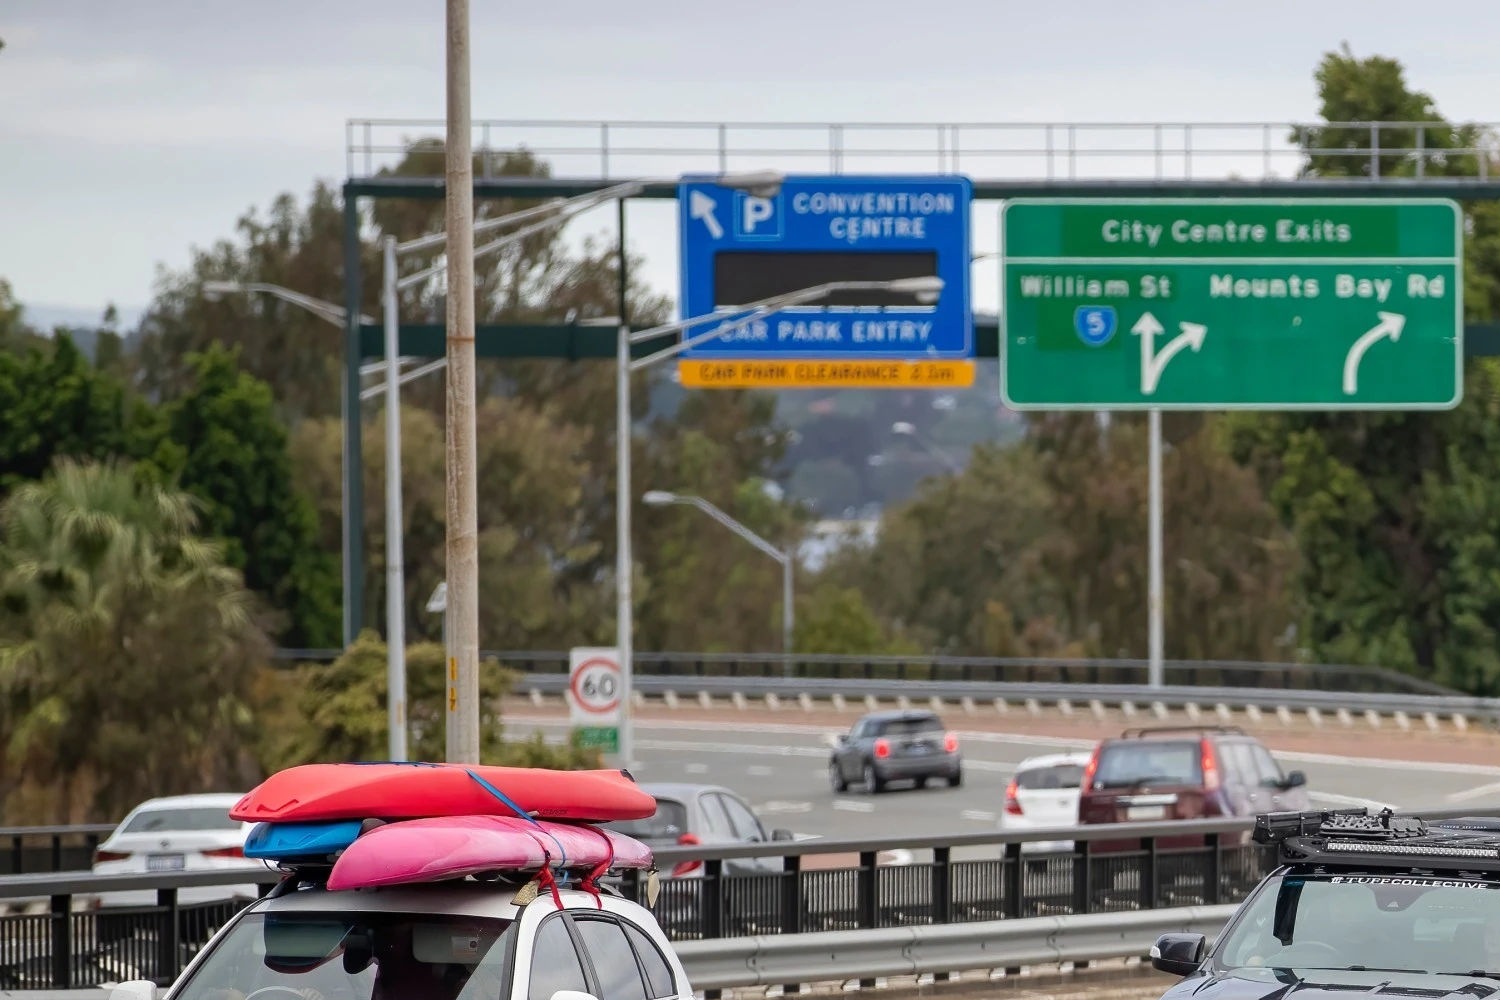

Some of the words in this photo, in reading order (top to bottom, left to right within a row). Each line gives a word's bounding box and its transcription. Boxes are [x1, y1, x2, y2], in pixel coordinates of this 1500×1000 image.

[743, 198, 773, 232] P
[793, 192, 954, 214] CONVENTION
[829, 217, 926, 239] CENTRE
[1101, 219, 1163, 246] City
[1171, 219, 1267, 243] Centre
[1276, 219, 1352, 243] Exits
[1020, 275, 1130, 298] William
[1140, 275, 1172, 298] St
[1209, 274, 1320, 298] Mounts
[1335, 274, 1392, 302] Bay
[1407, 274, 1446, 298] Rd
[777, 321, 842, 341] PARK
[852, 321, 932, 341] ENTRY
[700, 364, 736, 380] CAR
[583, 672, 615, 698] 60
